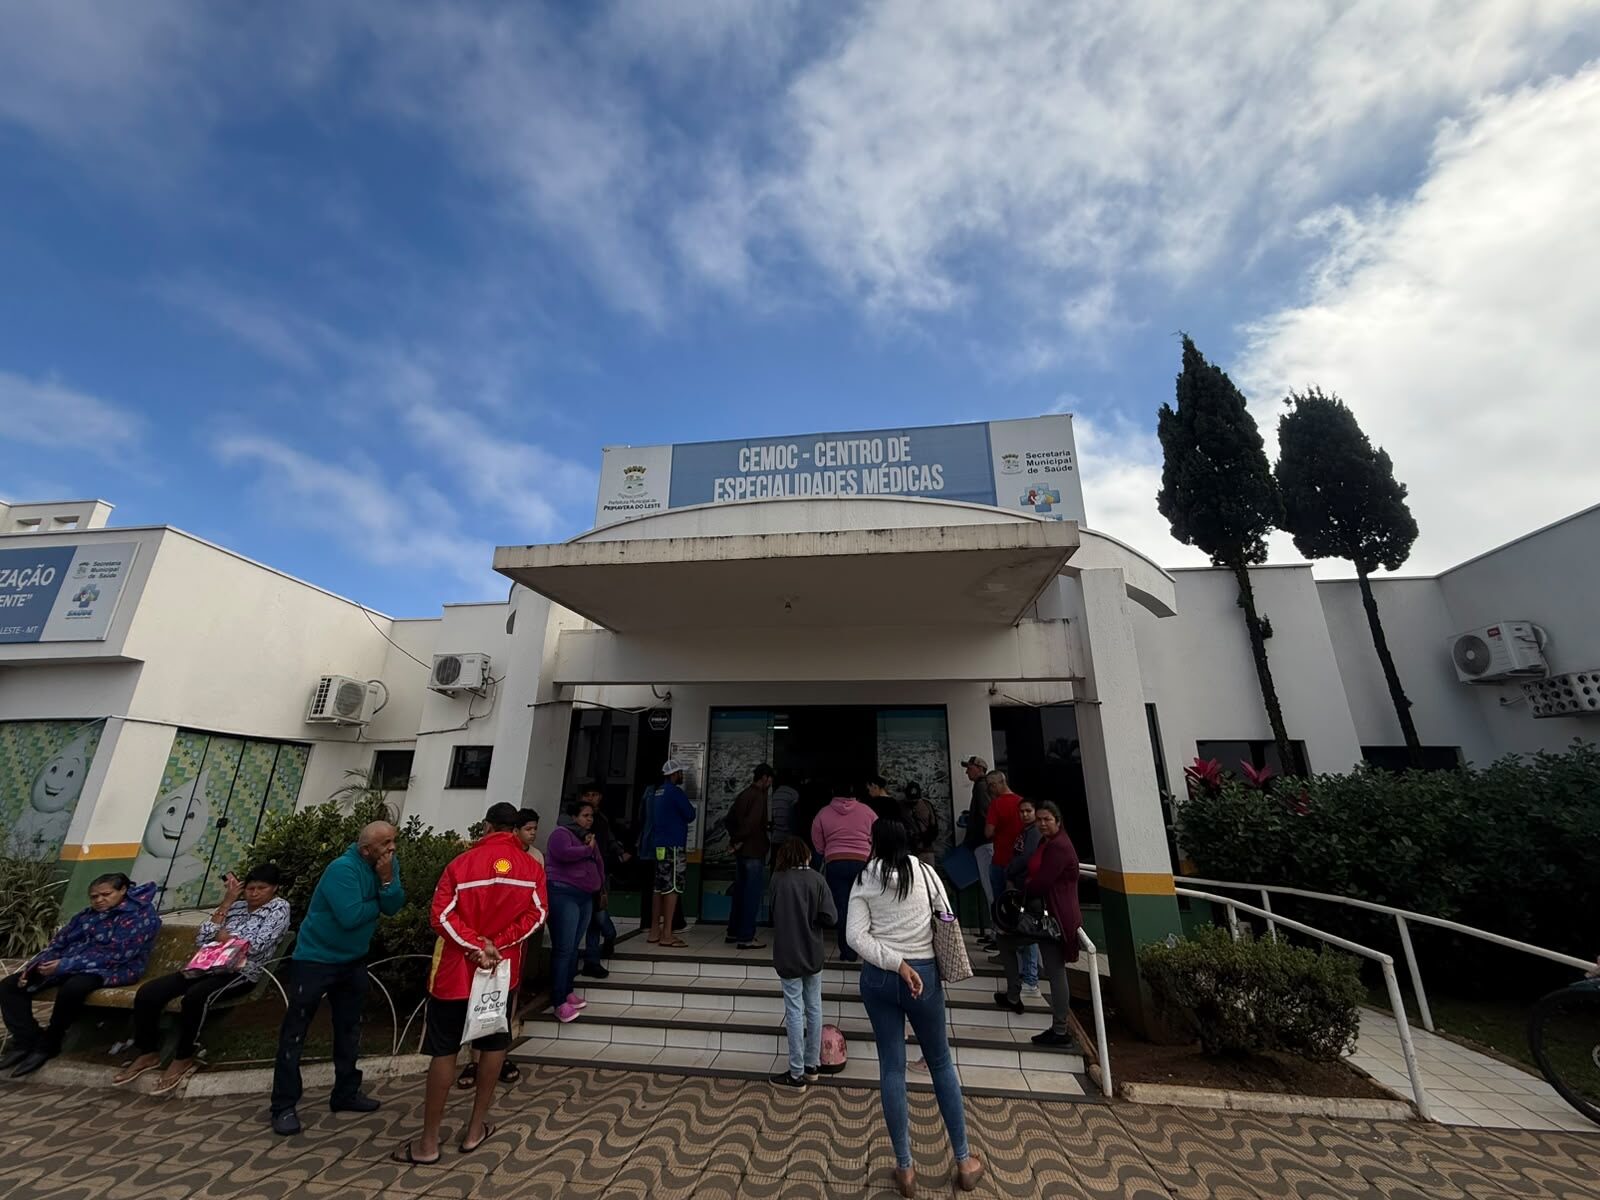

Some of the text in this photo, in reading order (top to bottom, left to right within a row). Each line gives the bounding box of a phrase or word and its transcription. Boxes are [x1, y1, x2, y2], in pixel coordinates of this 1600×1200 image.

[739, 444, 798, 473] CEMOC
[814, 438, 883, 467] CENTRO
[887, 436, 912, 463] DE
[1025, 450, 1071, 459] Secretaria
[1026, 457, 1072, 467] Municipal
[713, 463, 945, 503] ESPECIALIDADES MÉDICAS
